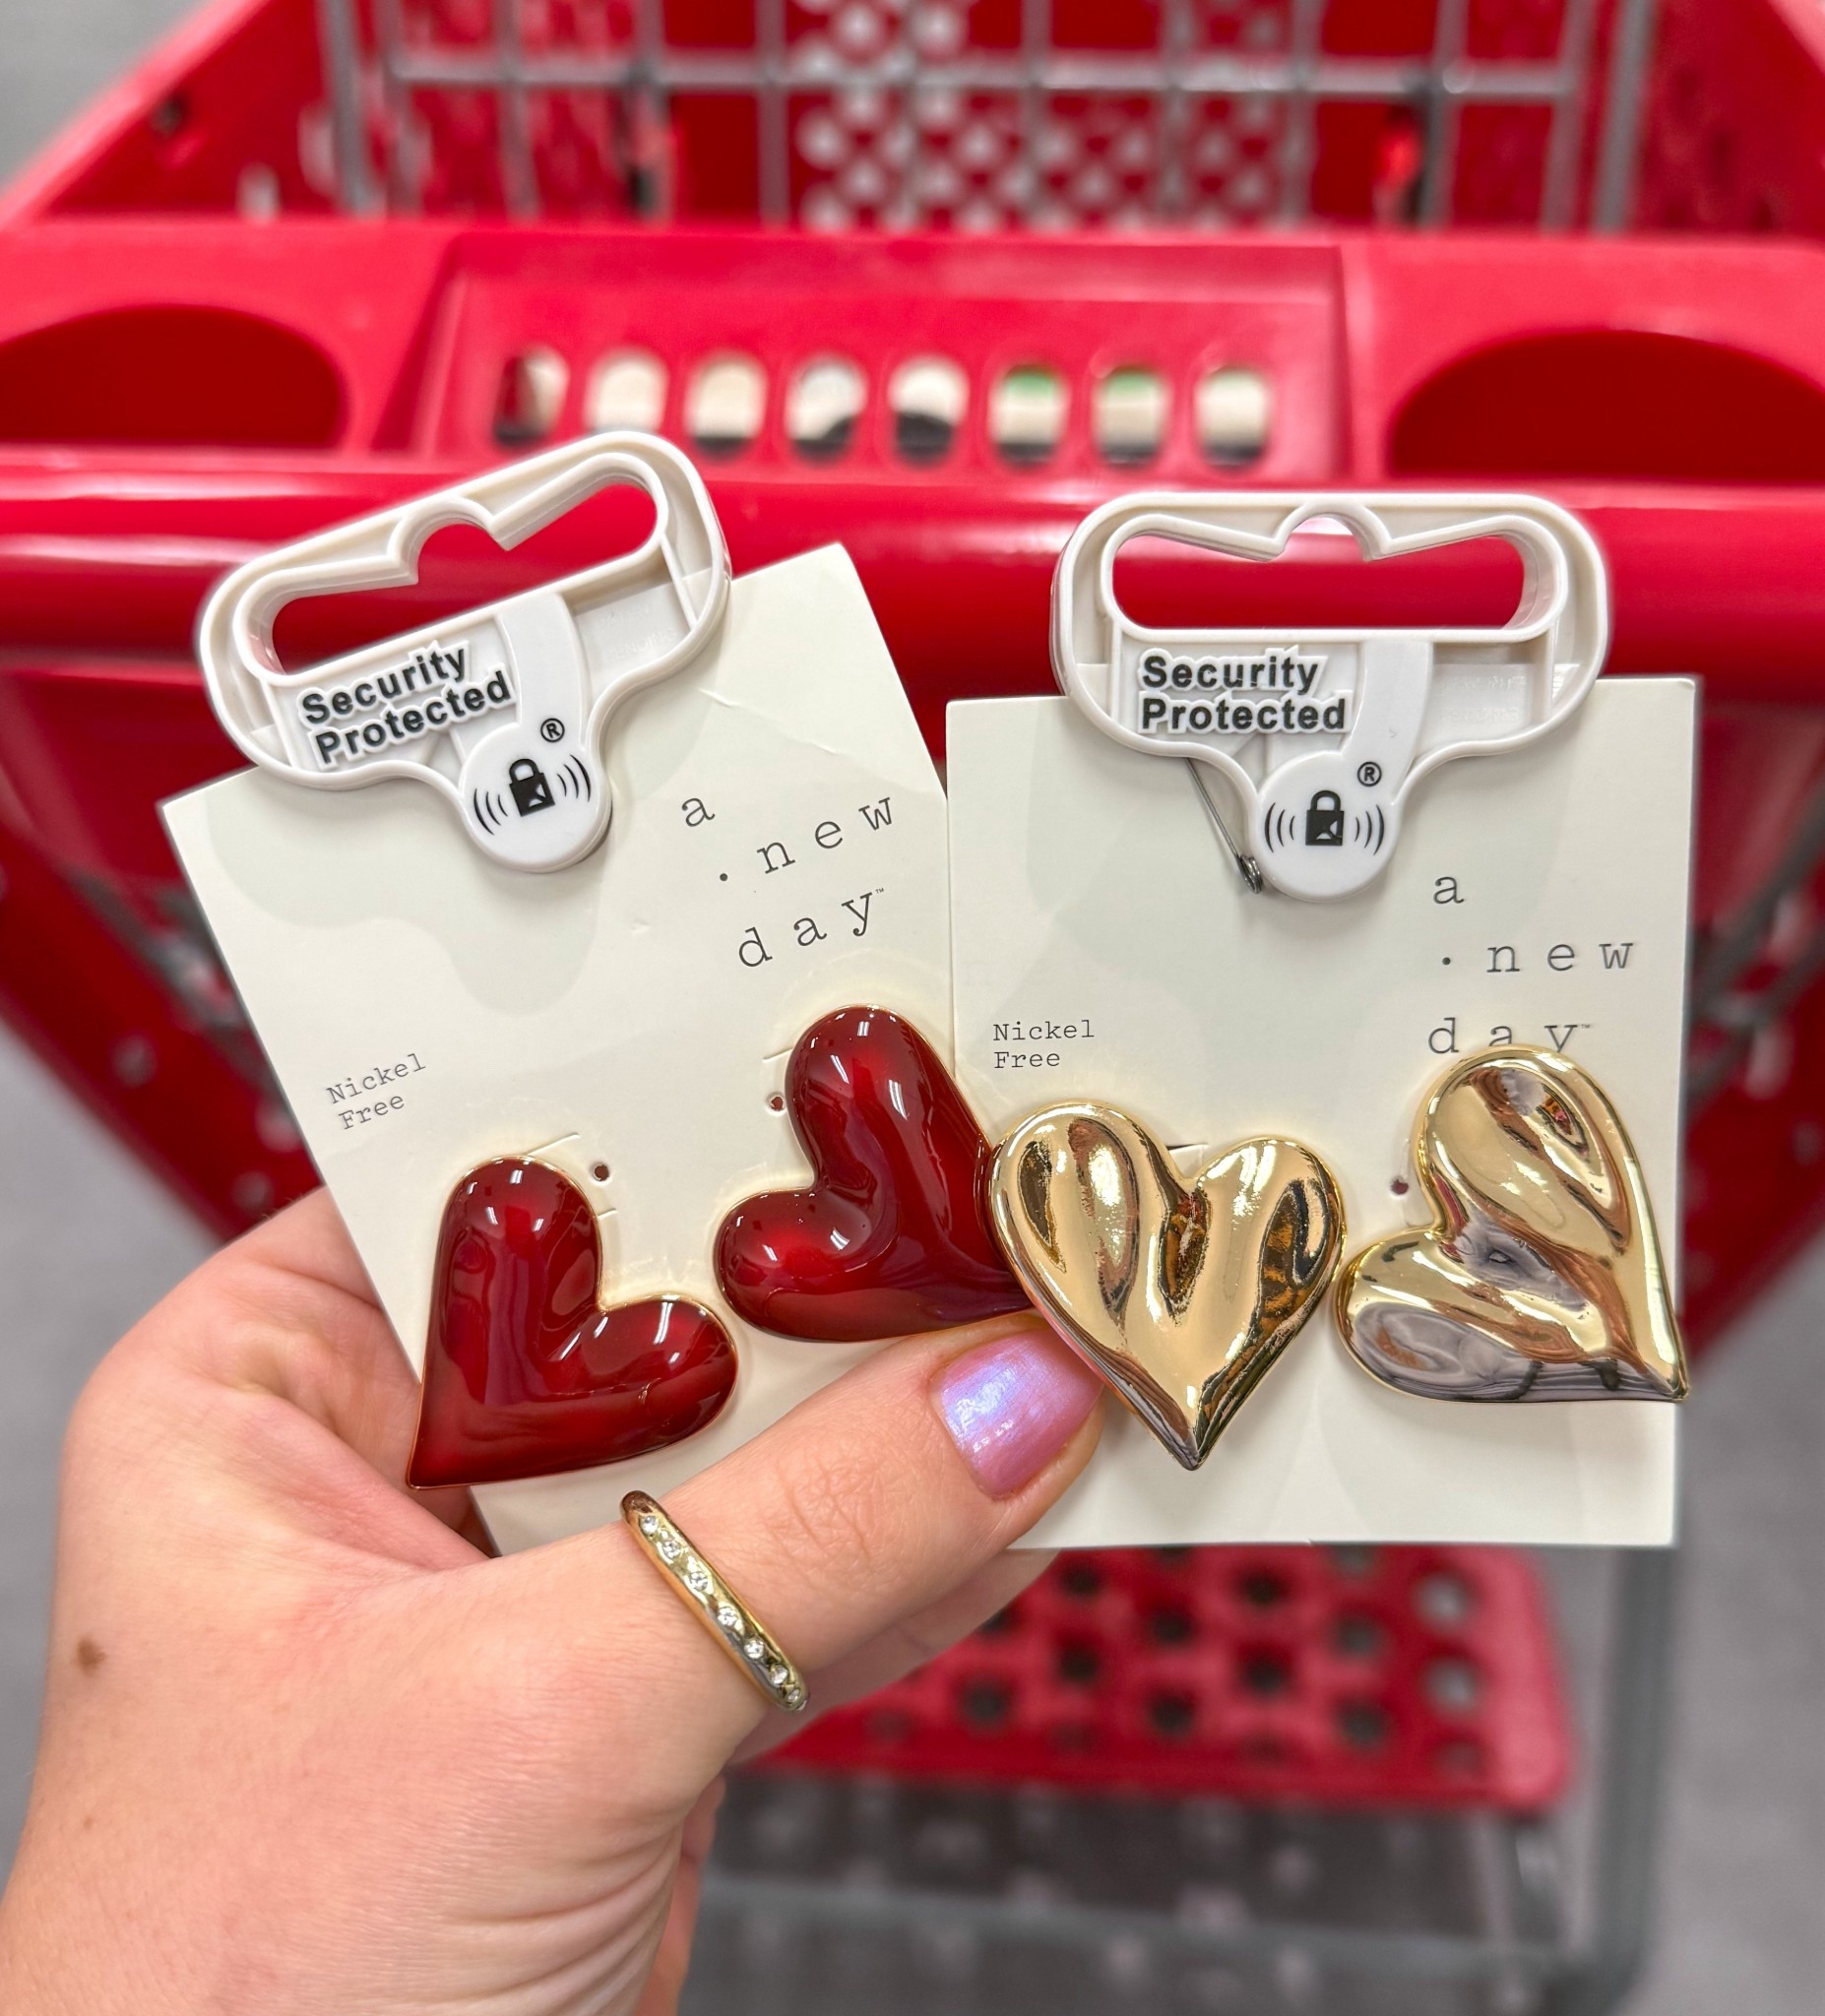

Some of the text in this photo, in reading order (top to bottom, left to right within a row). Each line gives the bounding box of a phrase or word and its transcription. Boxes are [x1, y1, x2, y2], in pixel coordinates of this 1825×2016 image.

[301, 647, 466, 725] Security
[1142, 655, 1319, 695] Security
[314, 669, 513, 765] Protected
[1142, 697, 1346, 730] Protected
[681, 797, 716, 827] a
[1432, 876, 1465, 905] a
[992, 1020, 1095, 1041] Nickel
[993, 1051, 1060, 1069] Free
[326, 1052, 426, 1104] Nickel
[338, 1095, 405, 1130] Free
